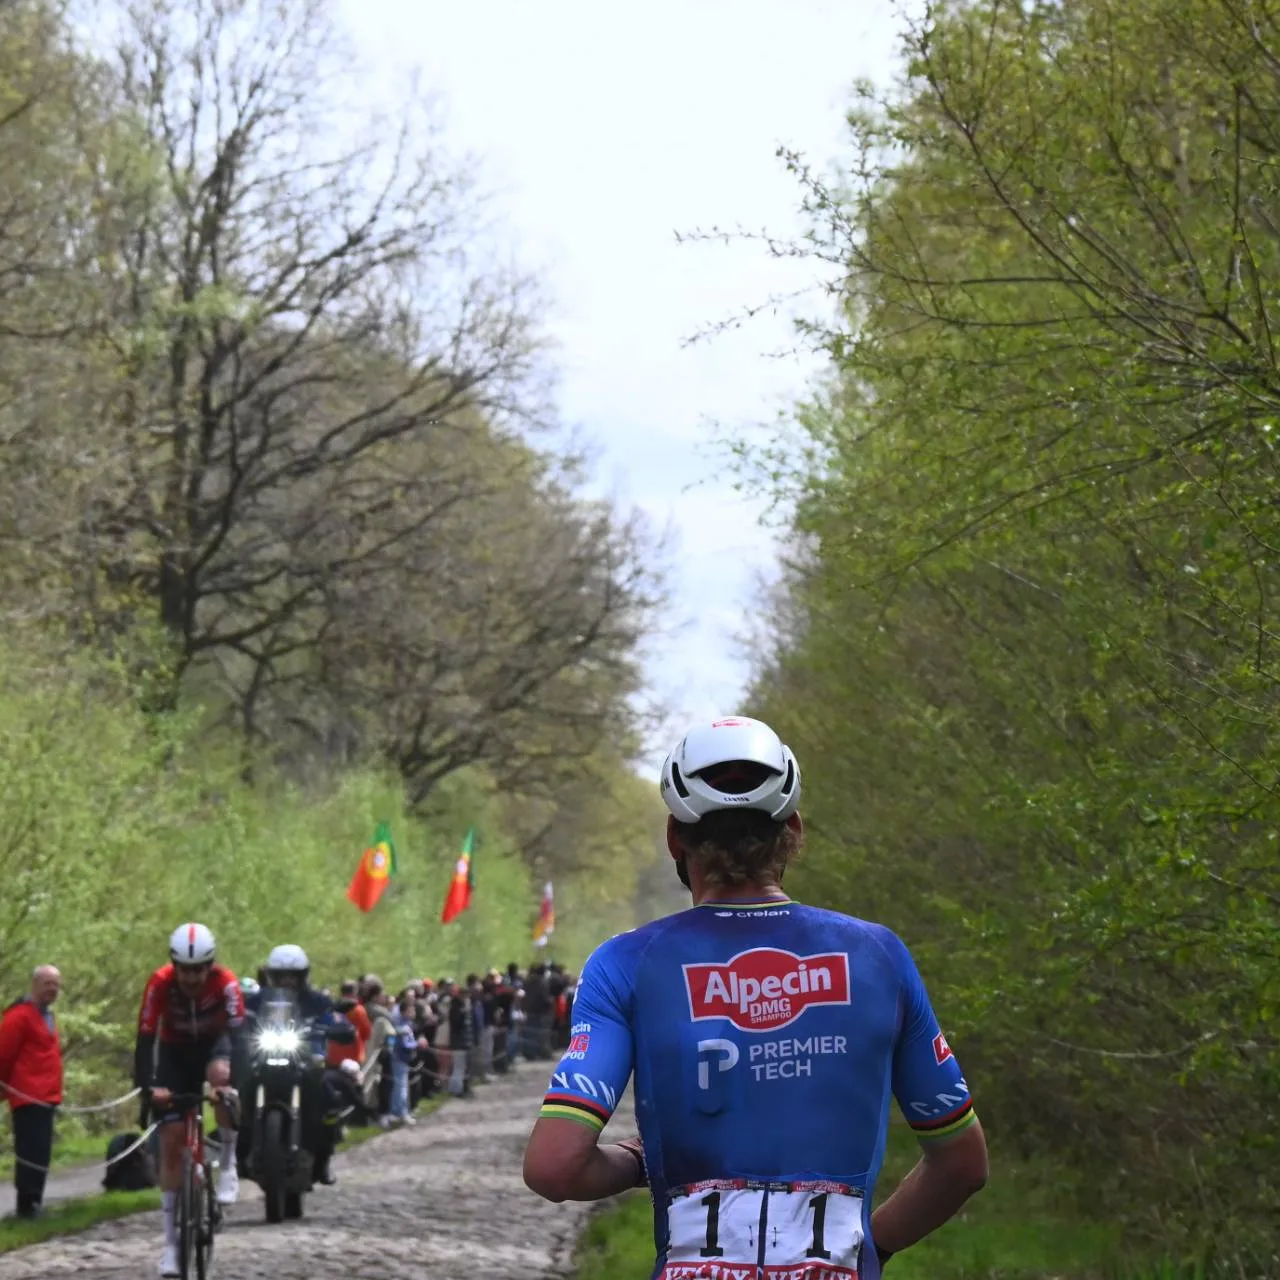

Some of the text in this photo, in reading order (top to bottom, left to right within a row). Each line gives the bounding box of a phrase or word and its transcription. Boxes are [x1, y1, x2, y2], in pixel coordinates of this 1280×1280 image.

[736, 910, 790, 918] crelan
[703, 963, 832, 1014] Alpecin
[749, 997, 792, 1018] DMG
[751, 1011, 792, 1024] SHAMPOO
[749, 1035, 847, 1062] PREMIER
[751, 1059, 812, 1082] TECH
[700, 1191, 724, 1257] 1
[806, 1192, 831, 1260] 1
